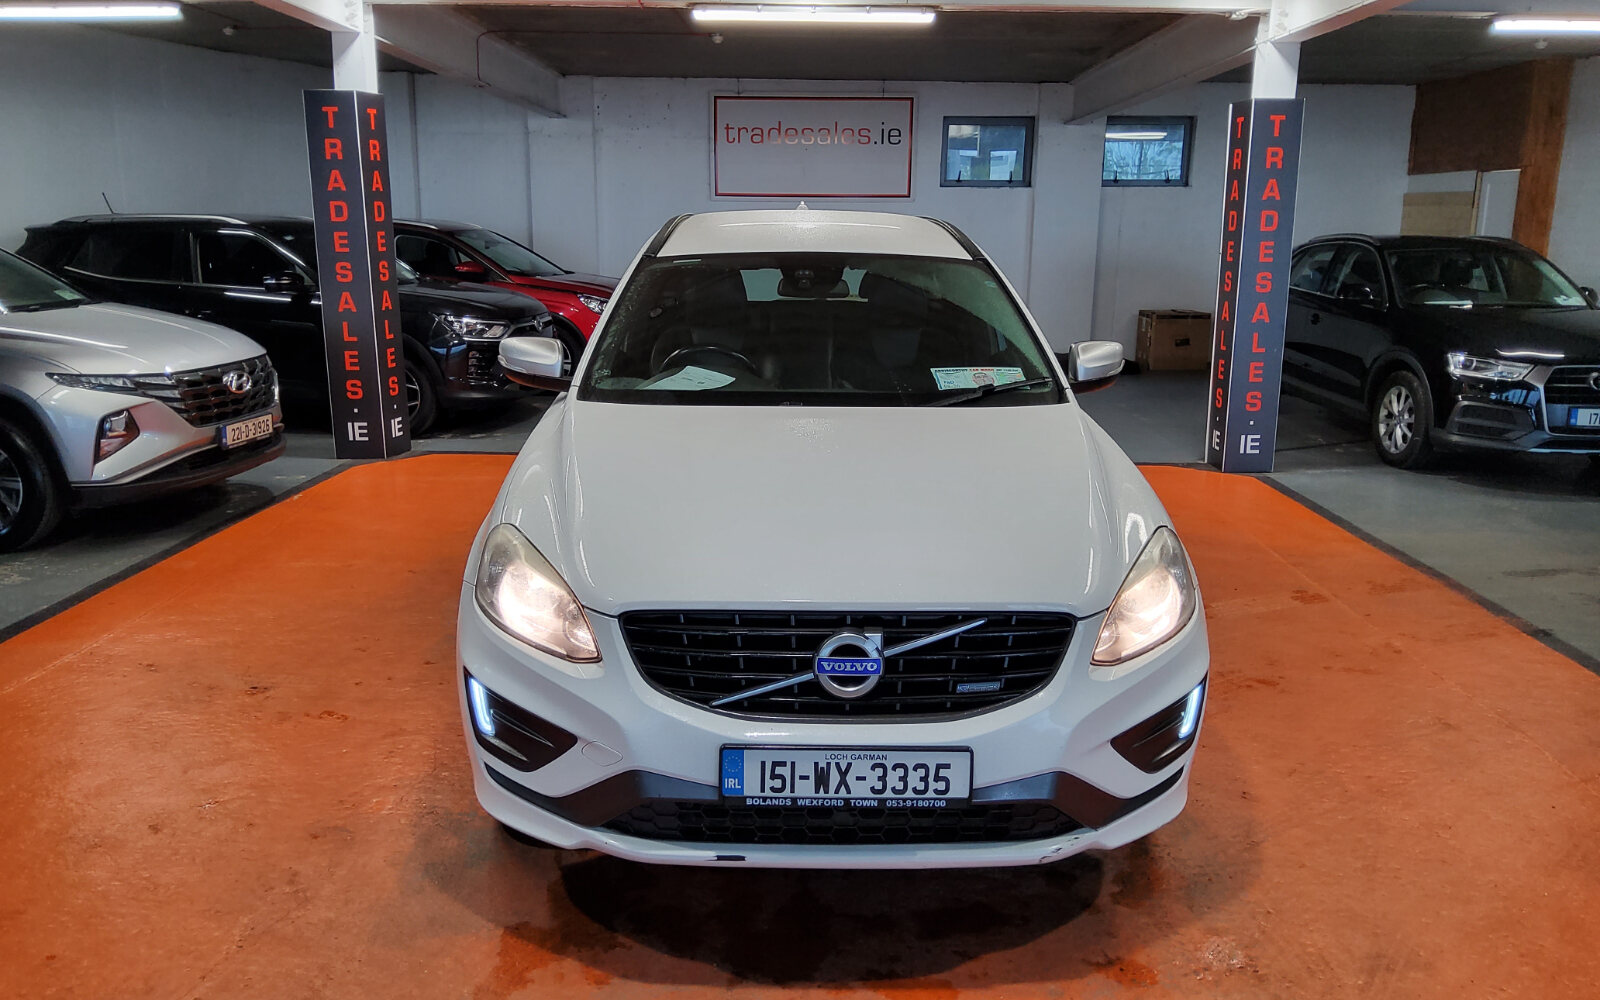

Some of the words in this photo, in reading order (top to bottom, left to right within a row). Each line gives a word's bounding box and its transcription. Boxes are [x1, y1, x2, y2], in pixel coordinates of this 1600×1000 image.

[724, 121, 902, 145] tradesales.ie
[1589, 412, 1600, 424] 17
[821, 661, 878, 672] VOLVO
[824, 753, 848, 761] LOCH
[850, 753, 888, 761] GARMAN
[725, 778, 742, 789] IRL
[760, 760, 951, 796] 151-WX-3335
[746, 798, 792, 806] BOLANDS
[797, 799, 844, 807] WEXFORD
[850, 800, 878, 808] TOWN
[886, 800, 946, 808] 053-9180700
